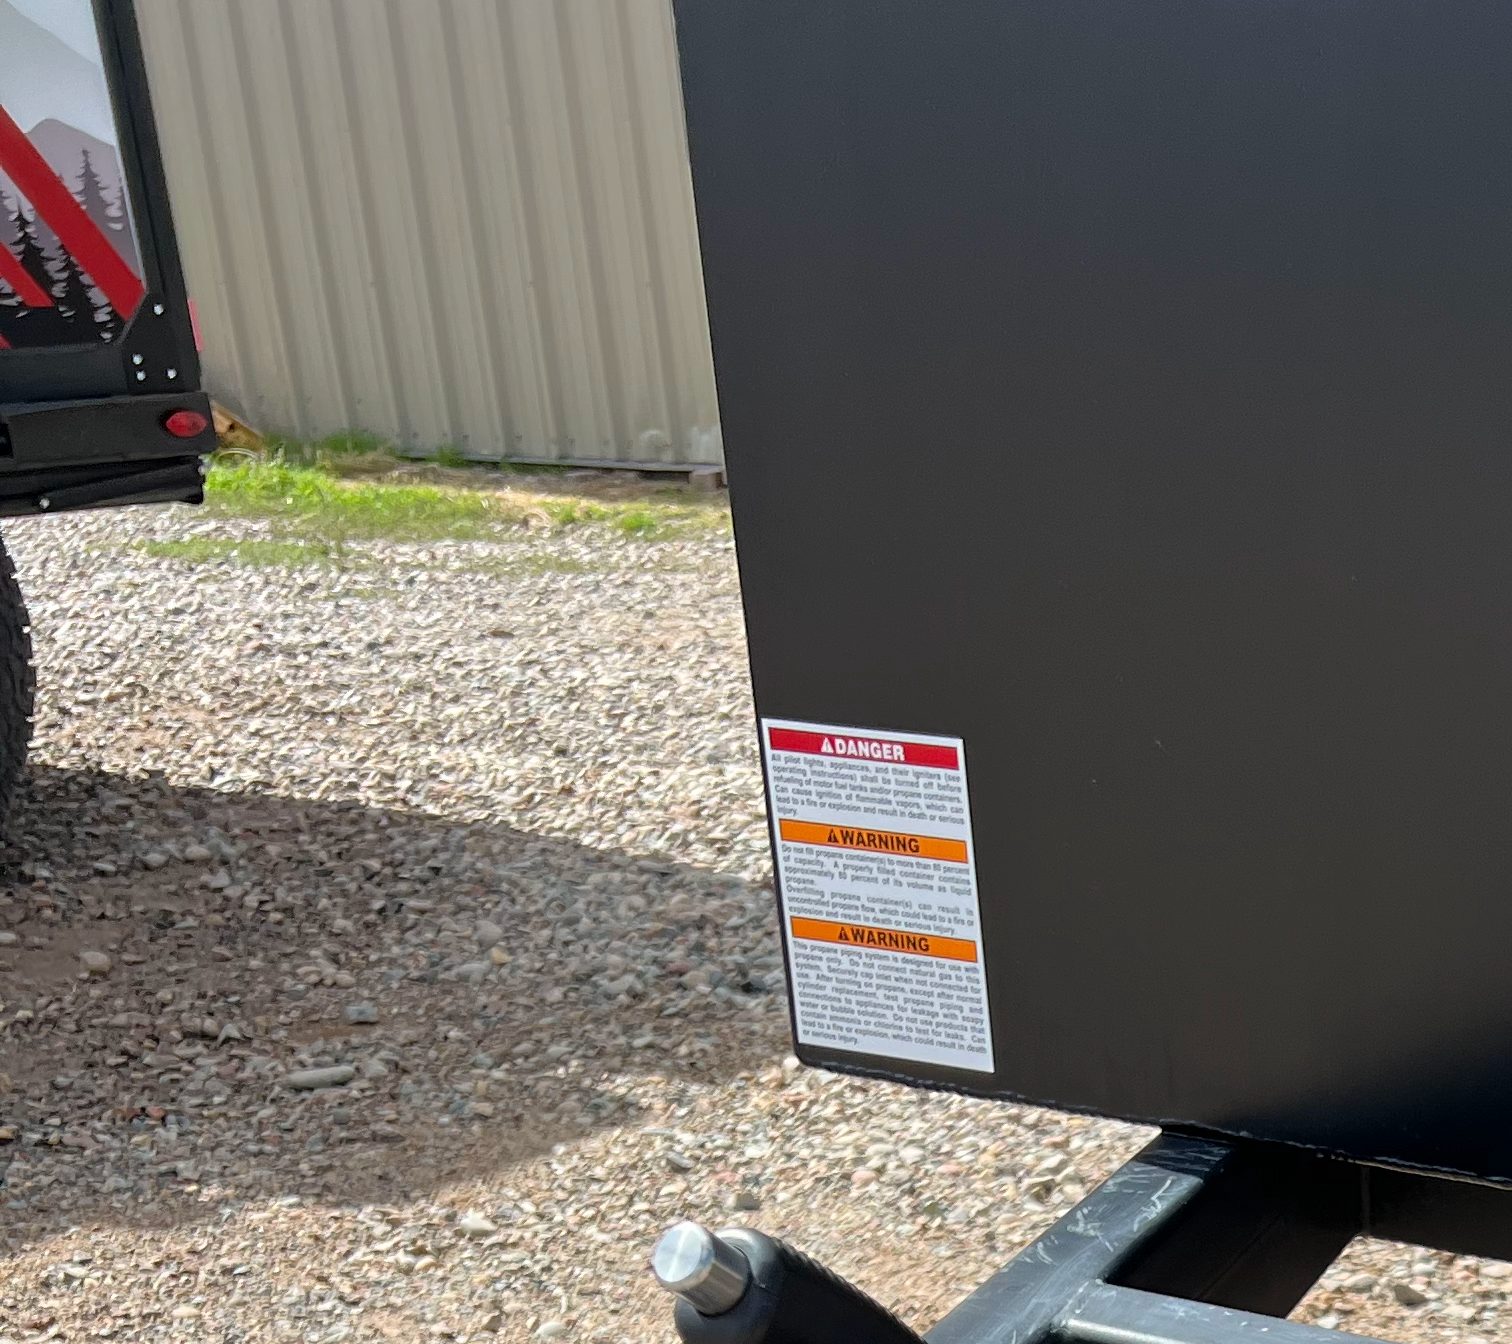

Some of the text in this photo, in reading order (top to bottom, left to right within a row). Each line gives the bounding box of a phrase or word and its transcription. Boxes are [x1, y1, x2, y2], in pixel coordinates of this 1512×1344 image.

[834, 738, 905, 761] DANGER
[840, 829, 919, 853] WARNING
[851, 928, 930, 954] WARNING
